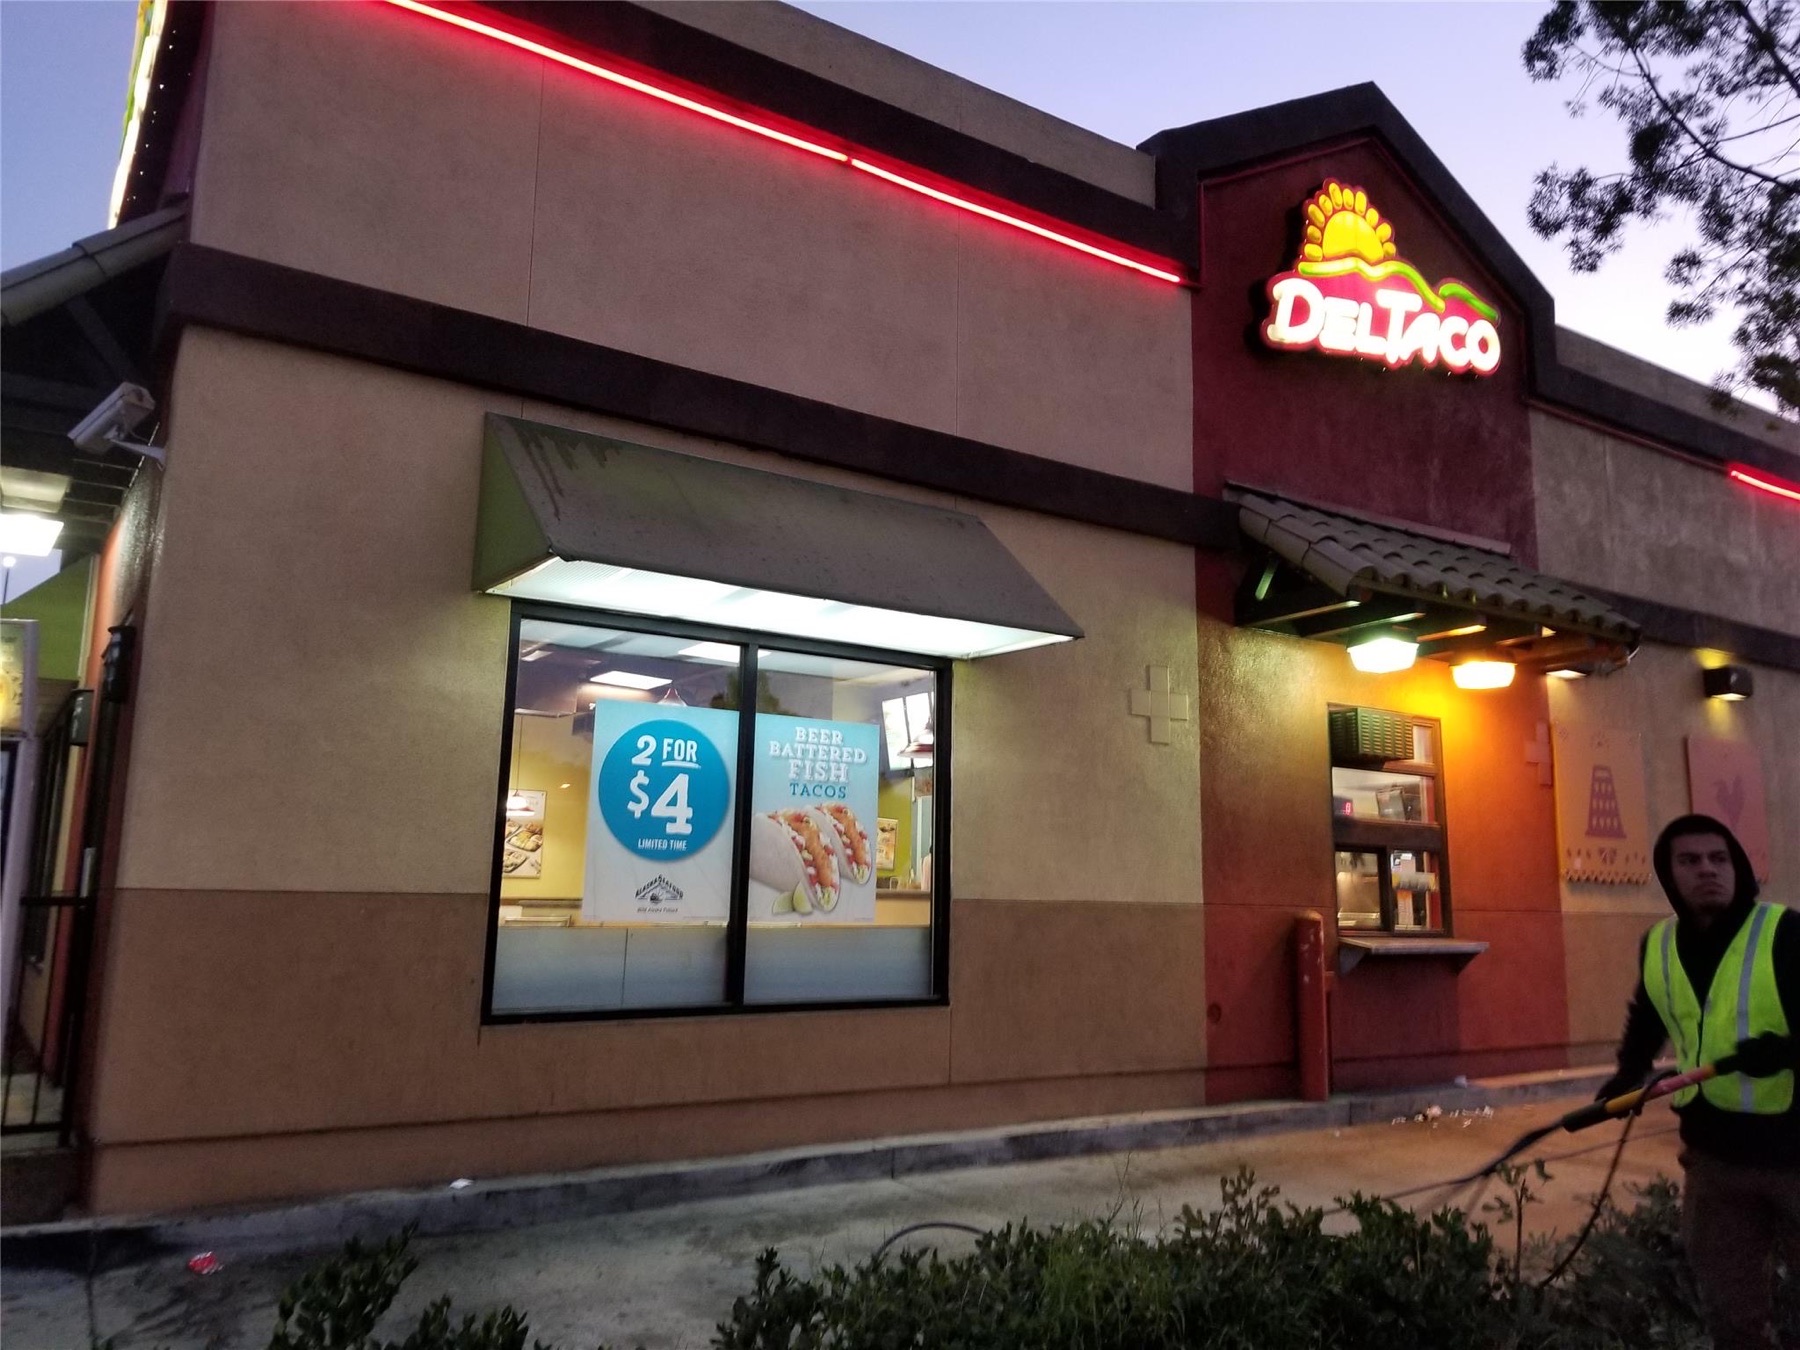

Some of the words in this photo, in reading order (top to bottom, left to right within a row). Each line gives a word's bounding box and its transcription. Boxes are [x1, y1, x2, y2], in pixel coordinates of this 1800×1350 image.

[795, 726, 844, 746] BEER
[631, 734, 657, 767] 2
[662, 738, 698, 762] FOR
[768, 740, 868, 764] BATTERED
[788, 758, 849, 783] FISH
[627, 769, 694, 836] $4
[789, 782, 847, 799] TACOS
[637, 838, 668, 850] LIMITED
[669, 839, 688, 852] TIME
